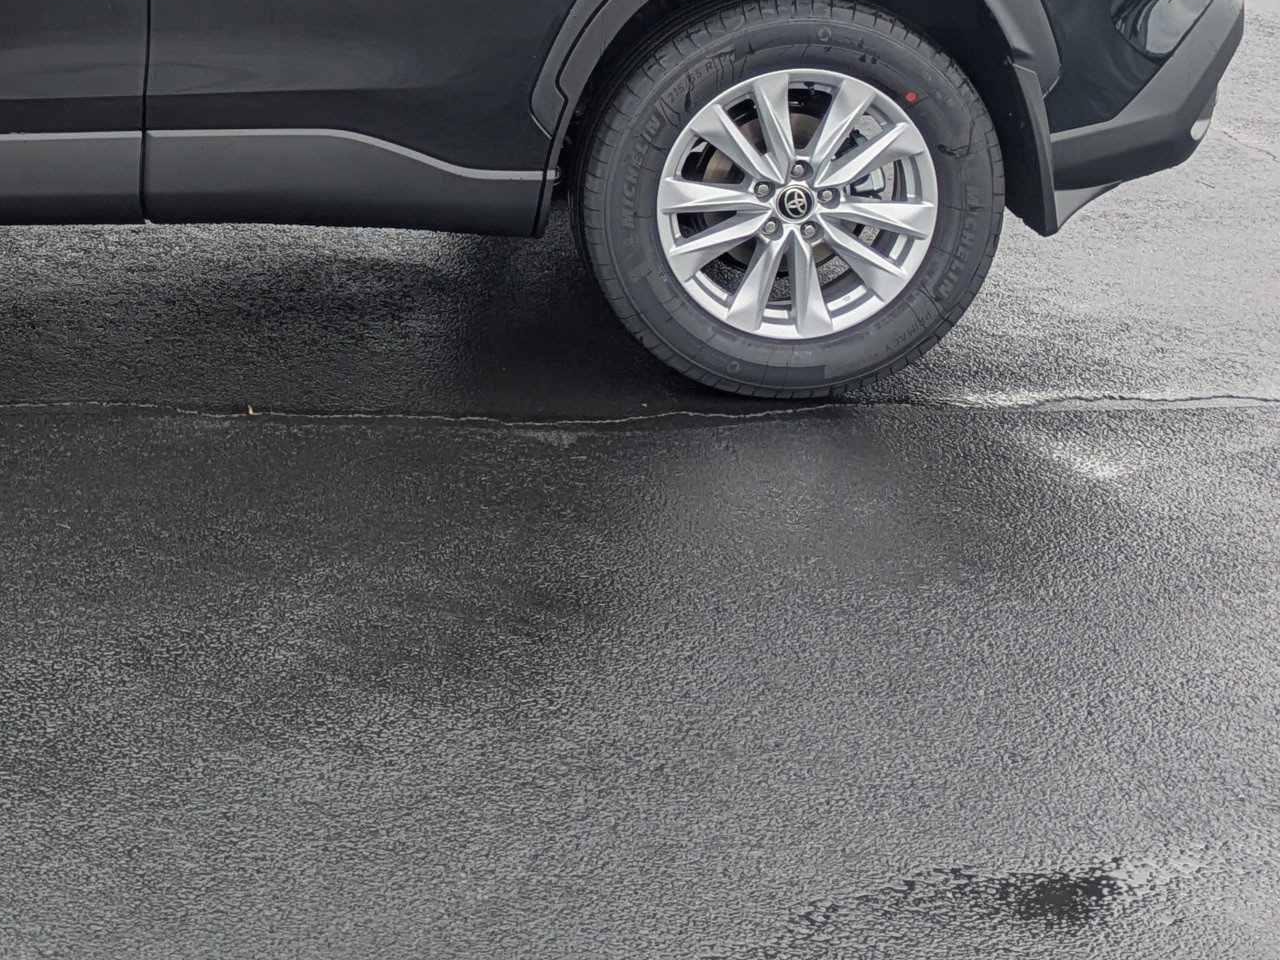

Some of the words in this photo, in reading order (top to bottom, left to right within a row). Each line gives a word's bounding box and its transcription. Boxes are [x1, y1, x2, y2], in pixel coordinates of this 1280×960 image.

[622, 112, 661, 228] MICHELIN
[938, 185, 978, 298] MICHELIN
[884, 311, 932, 354] PRIMACY
